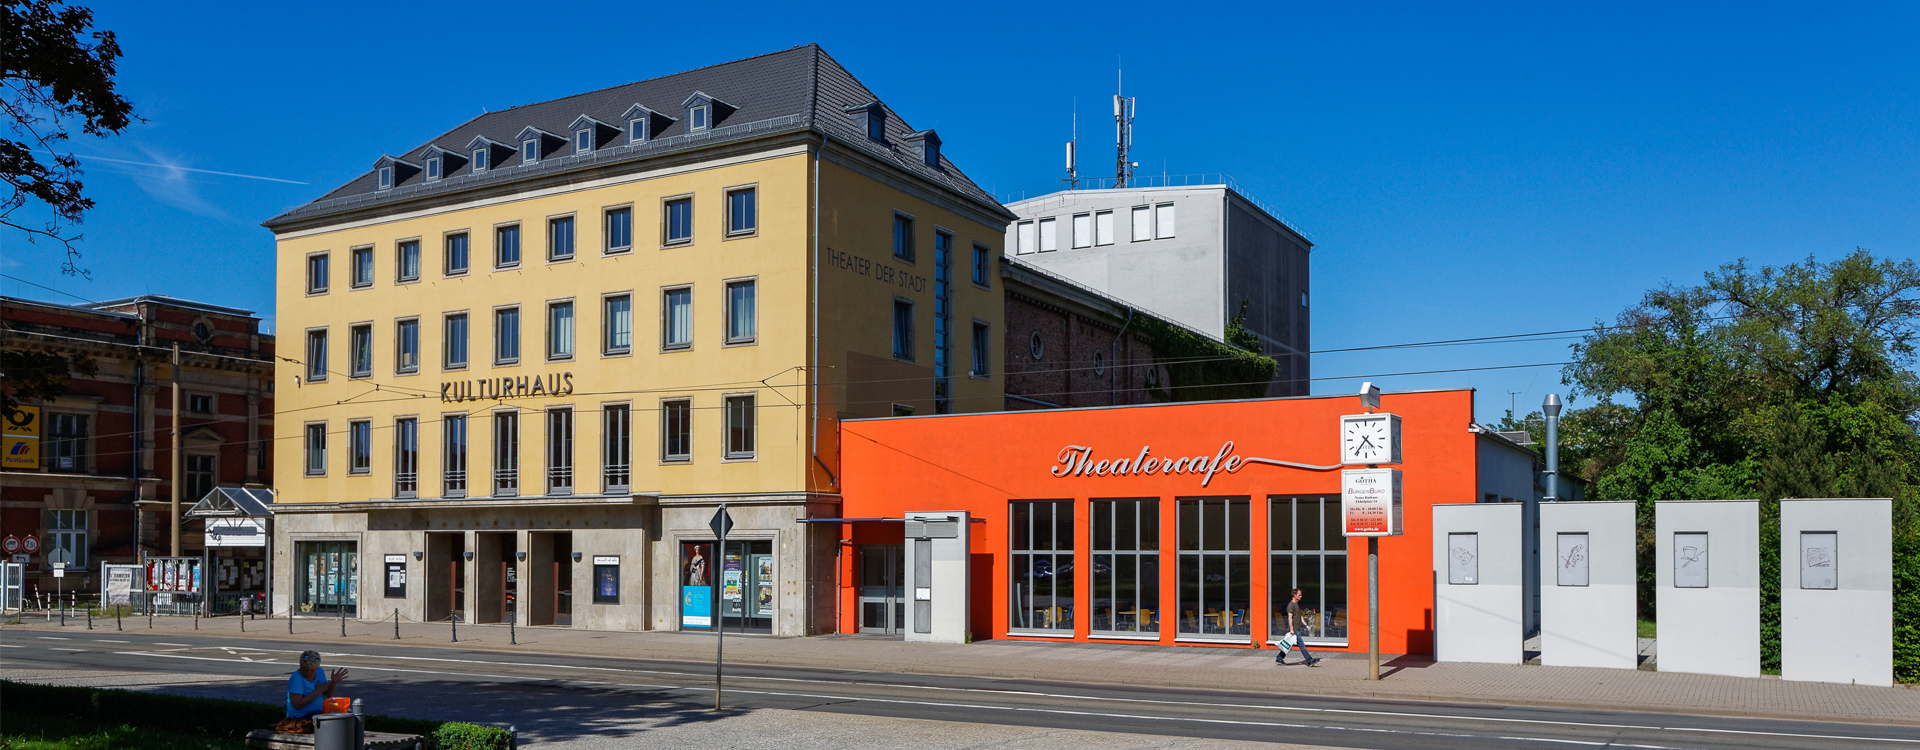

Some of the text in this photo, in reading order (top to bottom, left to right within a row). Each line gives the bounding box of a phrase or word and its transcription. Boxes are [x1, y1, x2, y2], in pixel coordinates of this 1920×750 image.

[826, 247, 927, 294] THEATER DER STADT
[441, 371, 574, 404] KULTURHAUS
[5, 456, 35, 464] Postbank
[1051, 440, 1241, 487] Theatercafe
